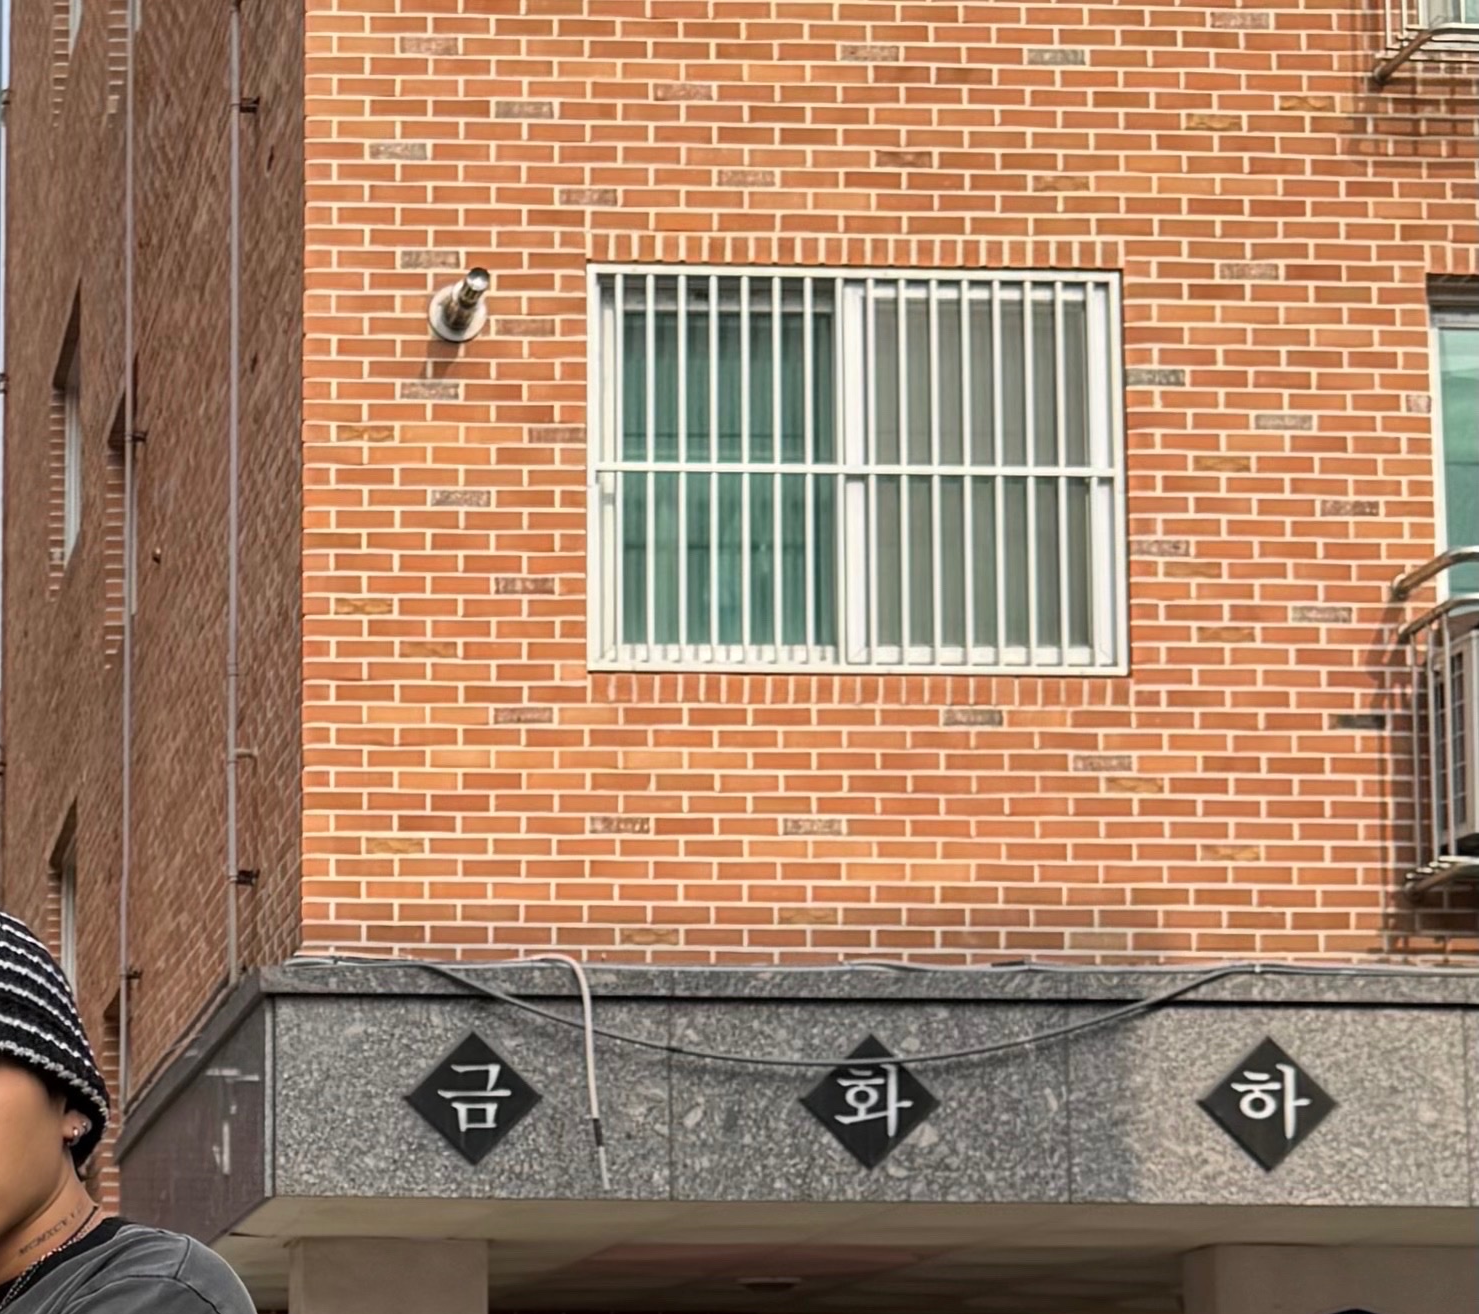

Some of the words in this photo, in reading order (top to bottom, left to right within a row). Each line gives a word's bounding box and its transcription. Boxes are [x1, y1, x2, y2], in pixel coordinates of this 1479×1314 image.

[437, 1063, 512, 1132] 금
[834, 1063, 914, 1138] 화
[1230, 1063, 1312, 1140] 하
